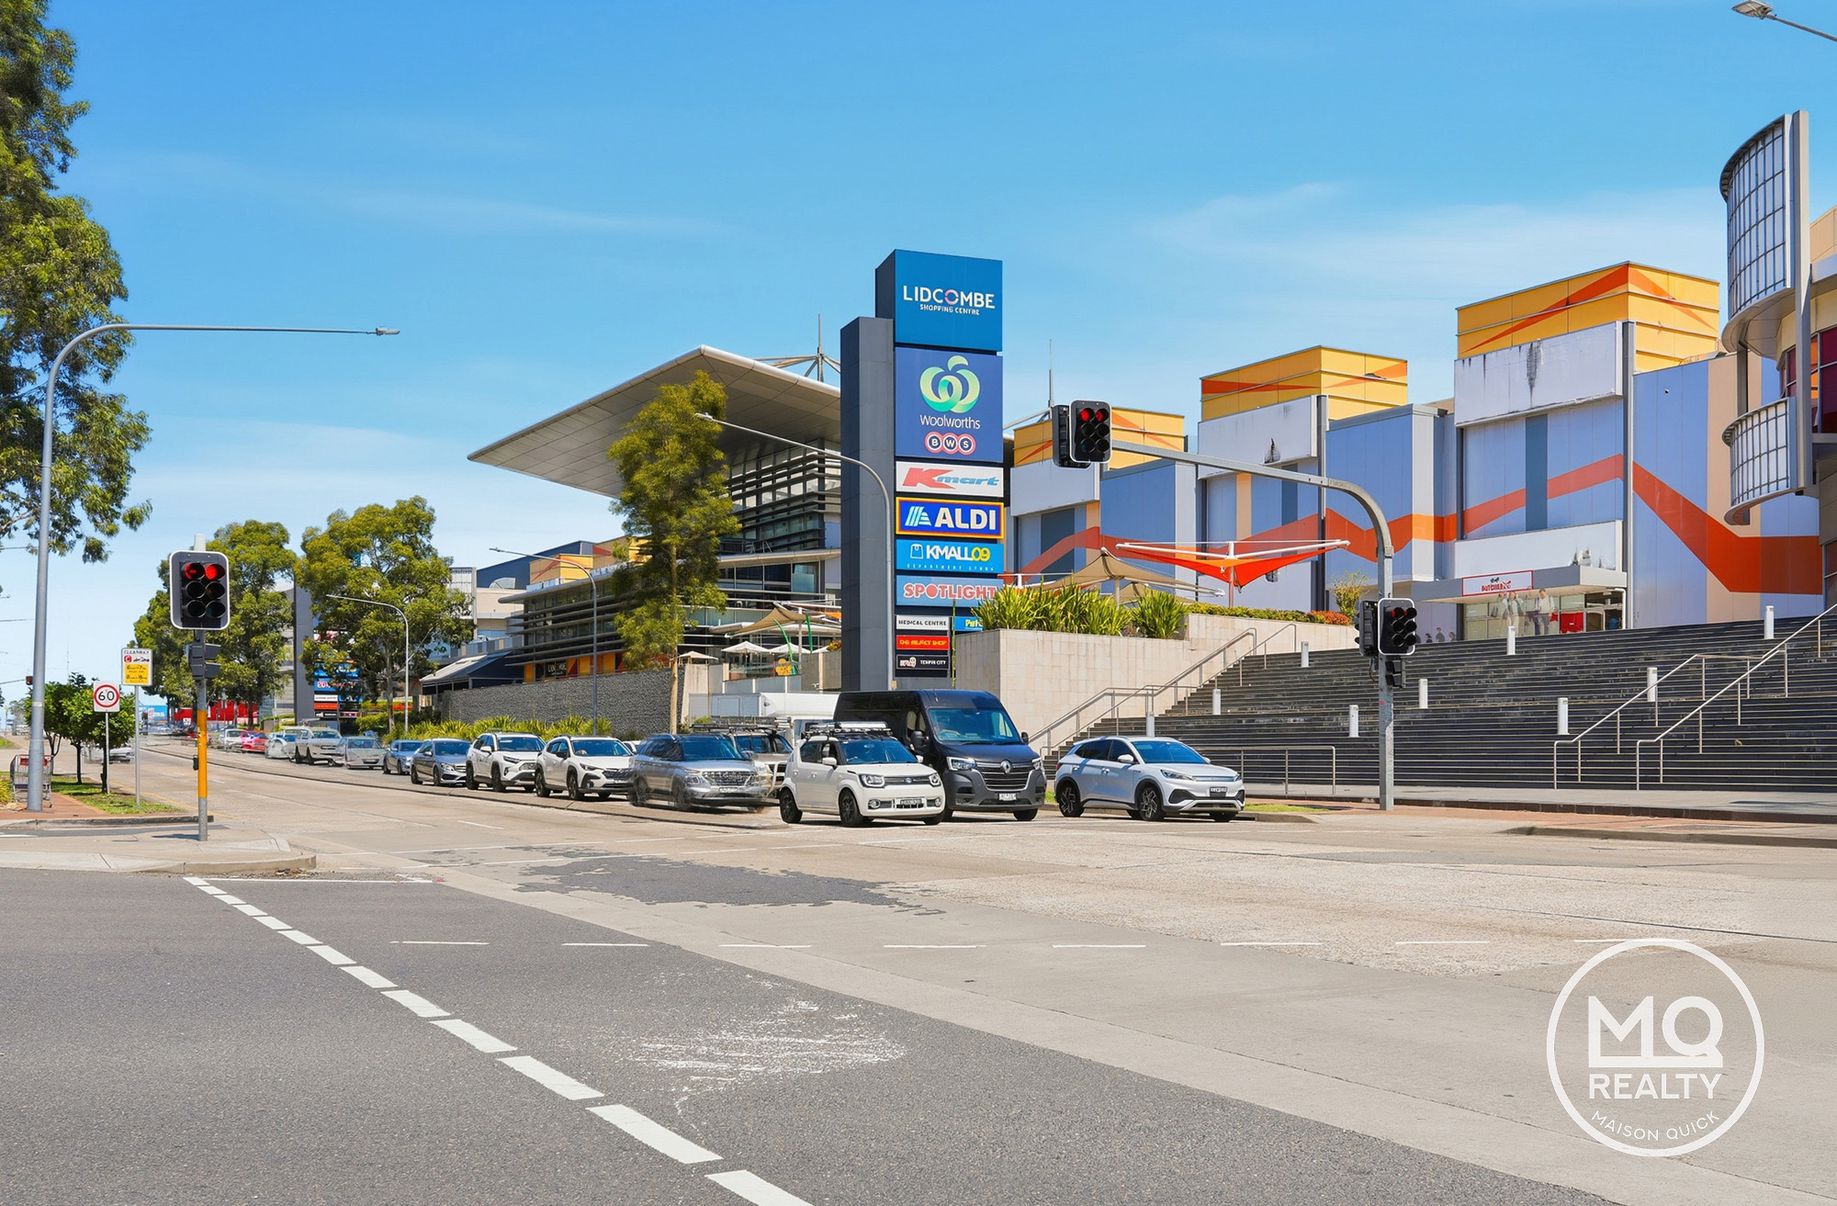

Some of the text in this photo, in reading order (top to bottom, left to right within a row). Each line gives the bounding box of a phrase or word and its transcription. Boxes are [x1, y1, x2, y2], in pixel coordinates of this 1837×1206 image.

[903, 286, 995, 309] LIDCOMBE
[920, 304, 980, 316] SHOPPING CENTRE
[919, 414, 981, 430] Woolworths
[929, 436, 972, 451] BWS
[902, 467, 1000, 490] Kmart
[934, 507, 996, 531] ALDI
[926, 545, 991, 562] KMALL09
[903, 583, 997, 600] SPOTLIGHT
[98, 690, 115, 701] 60
